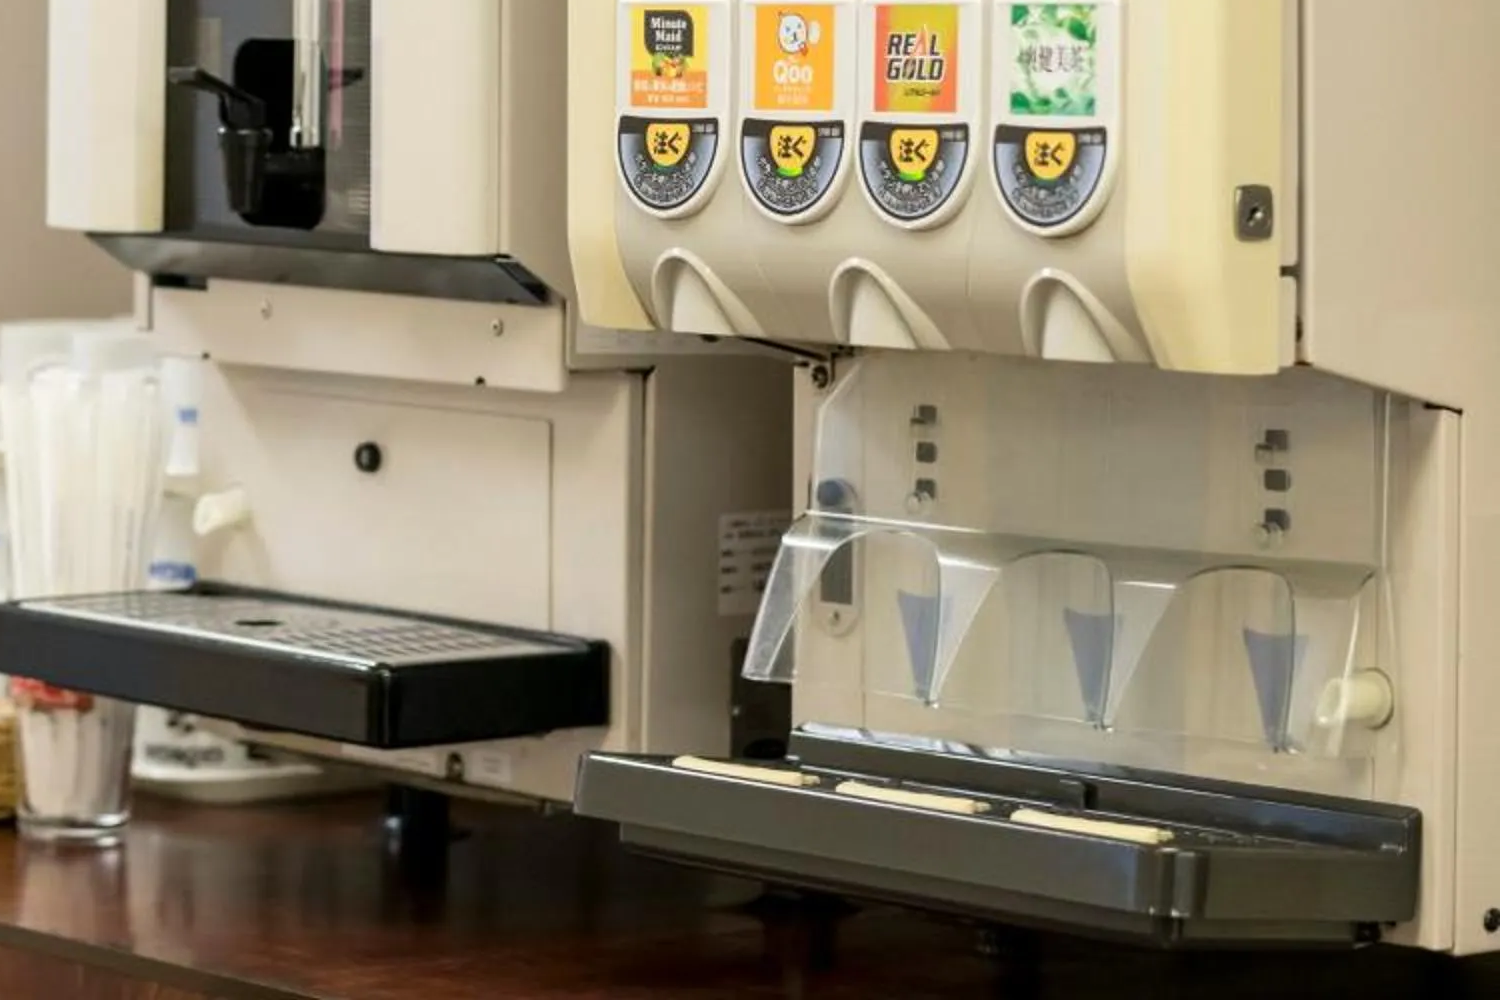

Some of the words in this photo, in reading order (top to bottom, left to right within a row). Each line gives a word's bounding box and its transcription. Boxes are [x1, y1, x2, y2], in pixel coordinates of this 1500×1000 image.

[655, 29, 682, 42] Maid
[887, 24, 942, 57] REAL
[773, 60, 814, 84] Qoo
[887, 58, 944, 81] GOLD
